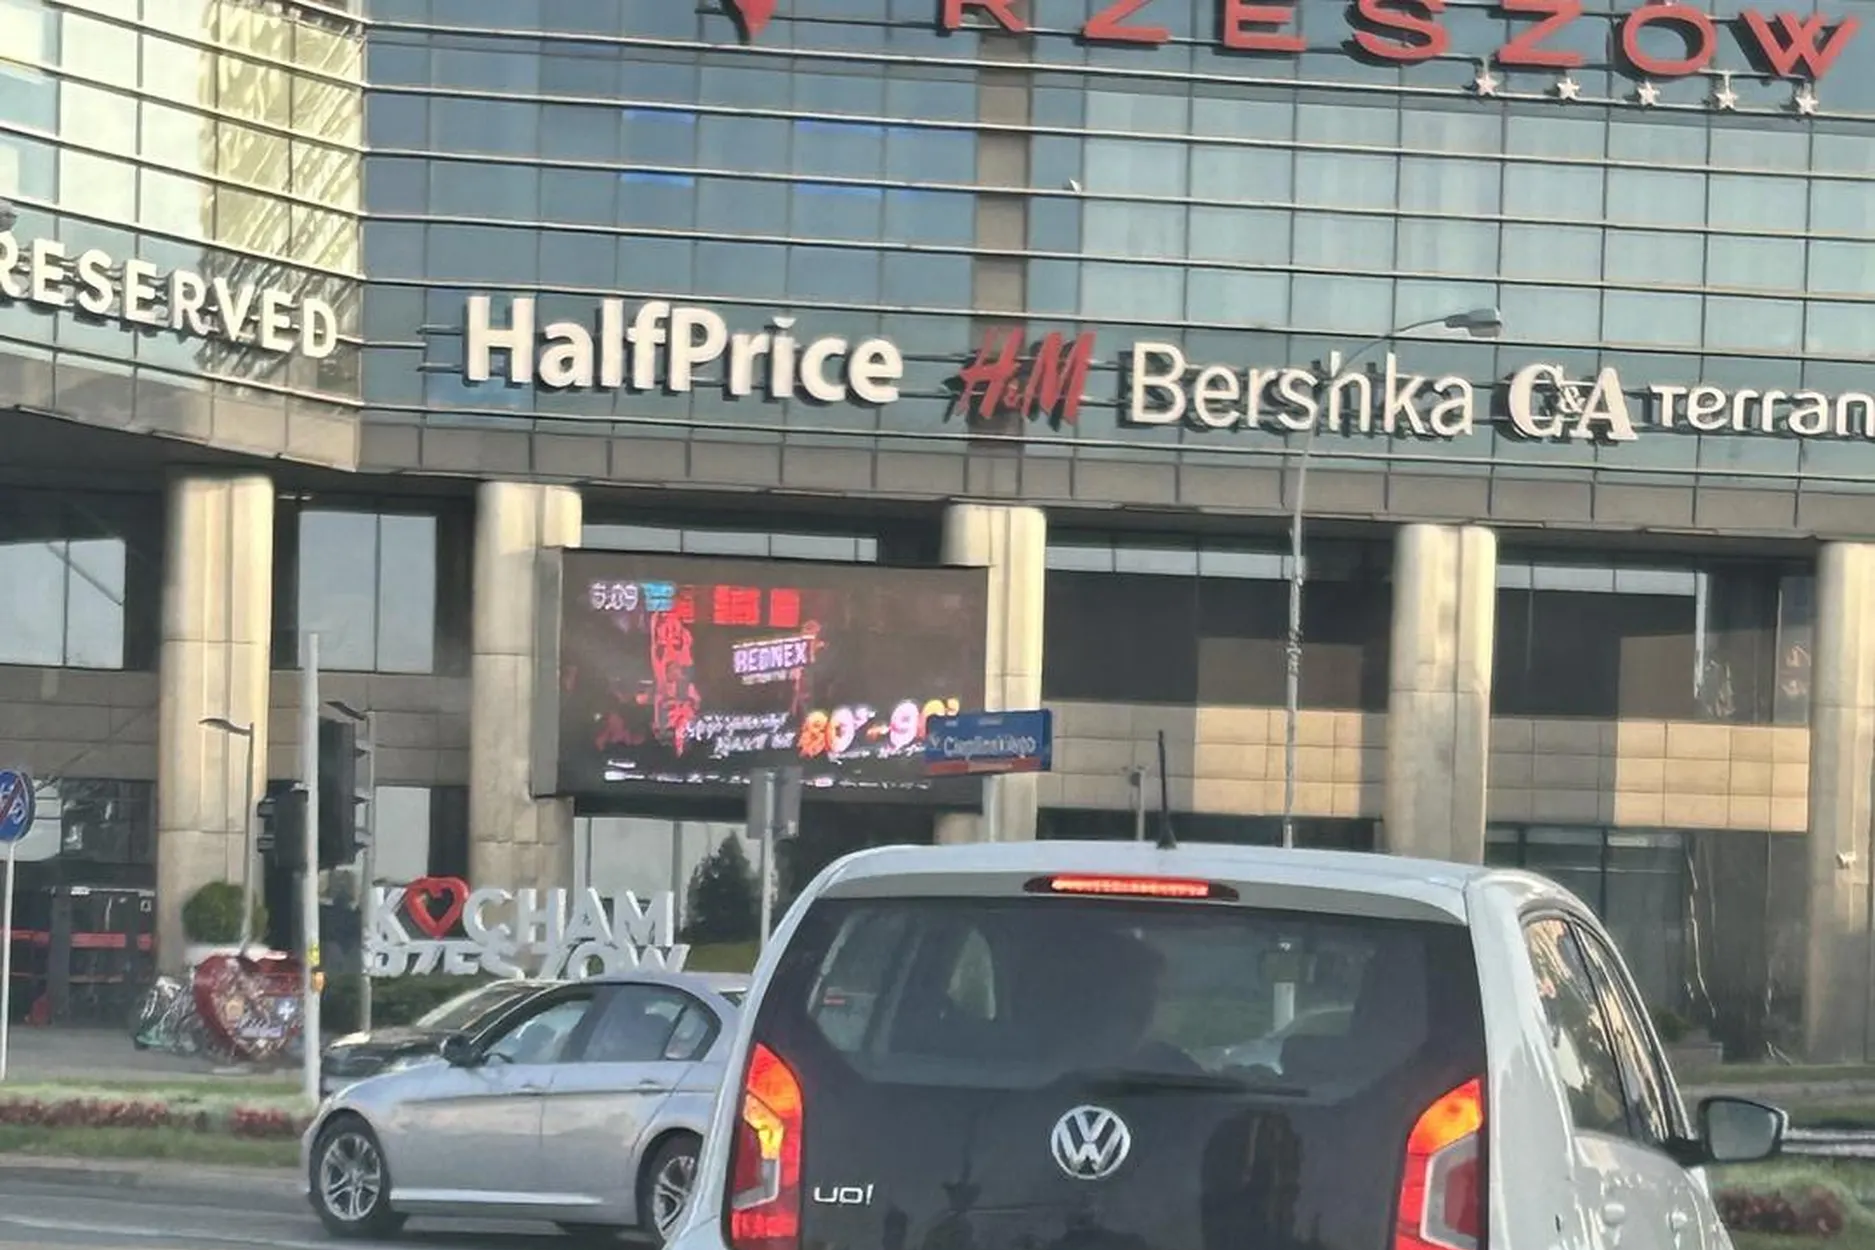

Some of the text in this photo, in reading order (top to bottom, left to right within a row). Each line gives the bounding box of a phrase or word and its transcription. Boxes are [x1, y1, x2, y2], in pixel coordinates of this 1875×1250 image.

[0, 230, 338, 358] RESERVED
[467, 296, 904, 403] HalfPrice
[953, 325, 1096, 427] H&M
[1131, 341, 1474, 437] Bershka
[1509, 364, 1639, 441] C&A
[813, 1183, 874, 1208] up!
